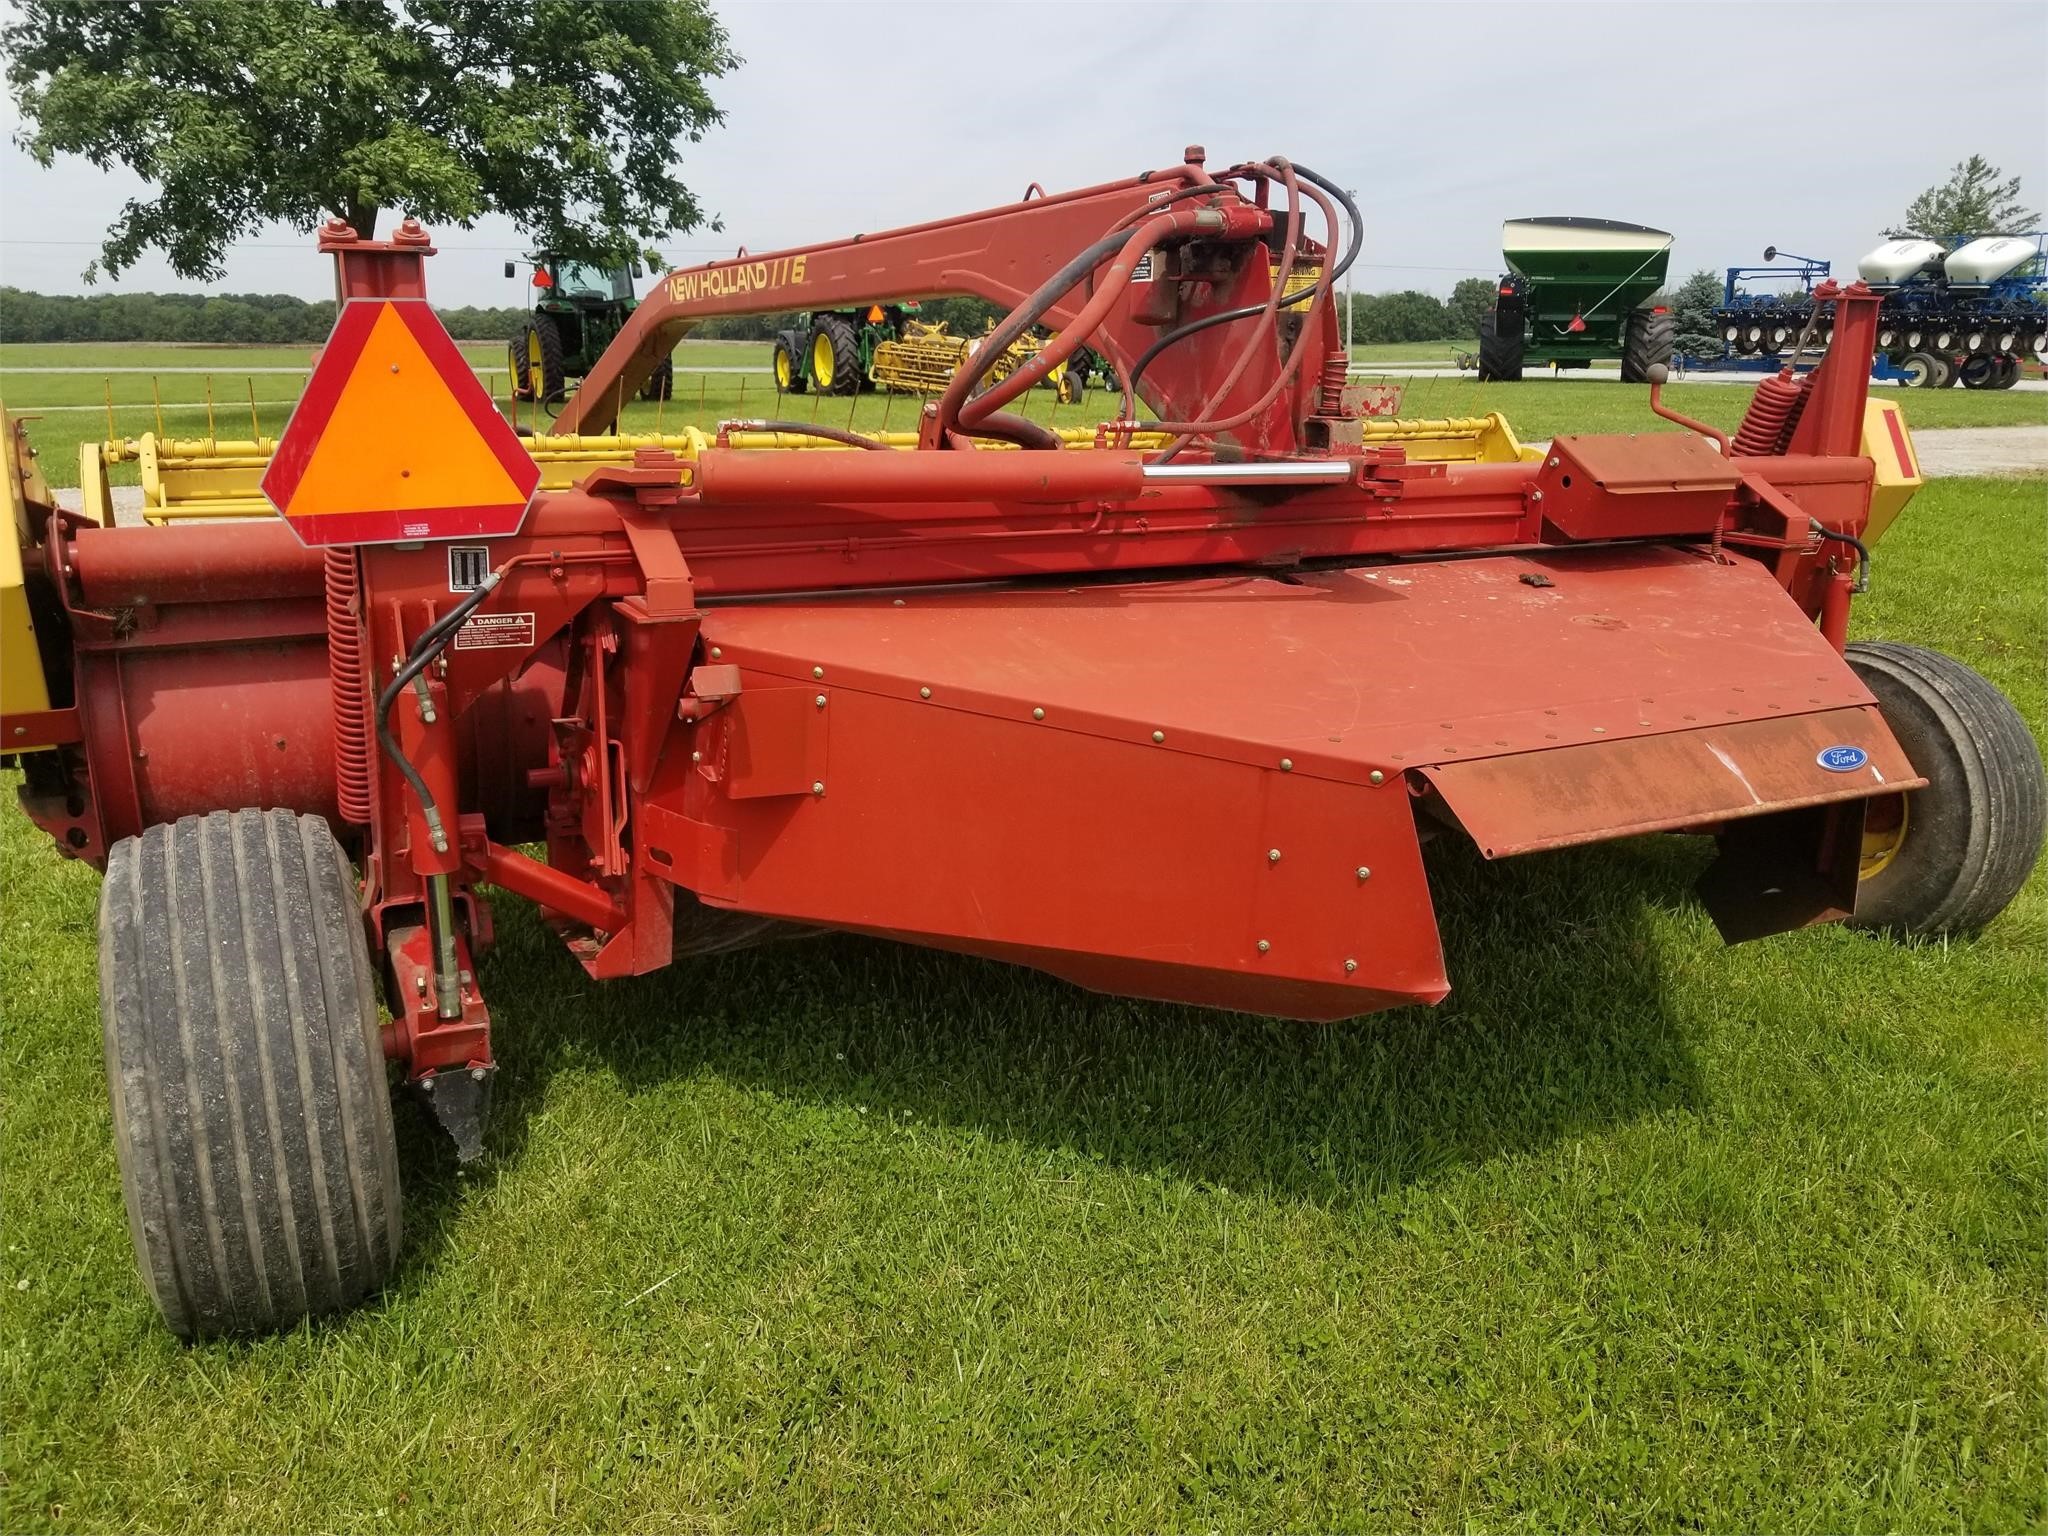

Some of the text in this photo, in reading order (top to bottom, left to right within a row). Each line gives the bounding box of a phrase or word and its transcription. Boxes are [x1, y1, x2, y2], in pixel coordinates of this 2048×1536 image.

[669, 255, 807, 303] NEW HOLLAND 116
[477, 617, 513, 625] DANGER
[1830, 750, 1857, 765] Ford
